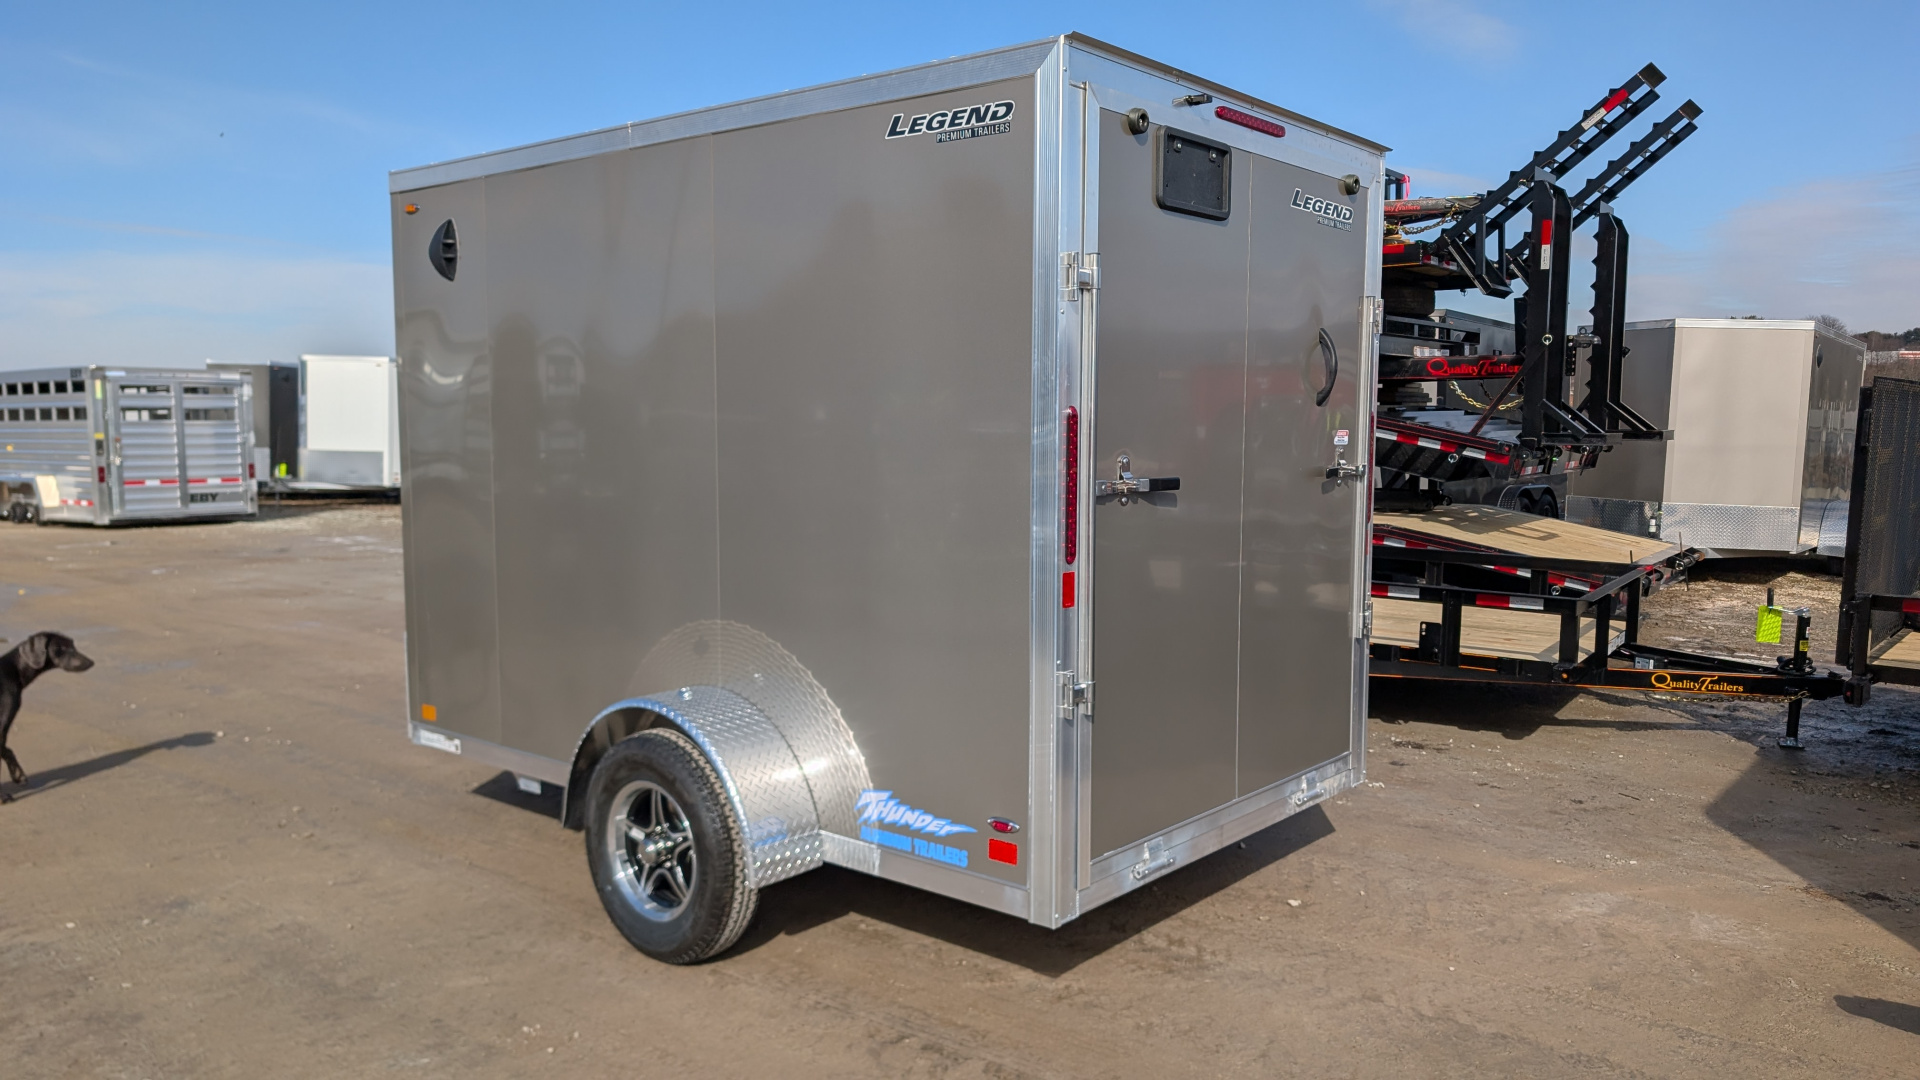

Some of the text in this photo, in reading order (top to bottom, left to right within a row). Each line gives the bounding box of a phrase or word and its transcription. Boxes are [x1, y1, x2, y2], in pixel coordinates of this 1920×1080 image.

[885, 100, 1015, 139] LEGEND
[936, 122, 1010, 143] PREMIUM TRAILERS
[1291, 188, 1354, 223] LEGEND
[1426, 357, 1520, 376] Quality Trailer
[190, 493, 219, 503] EBY
[1651, 672, 1744, 692] Quality Trailers
[913, 838, 968, 868] TRAILERS
